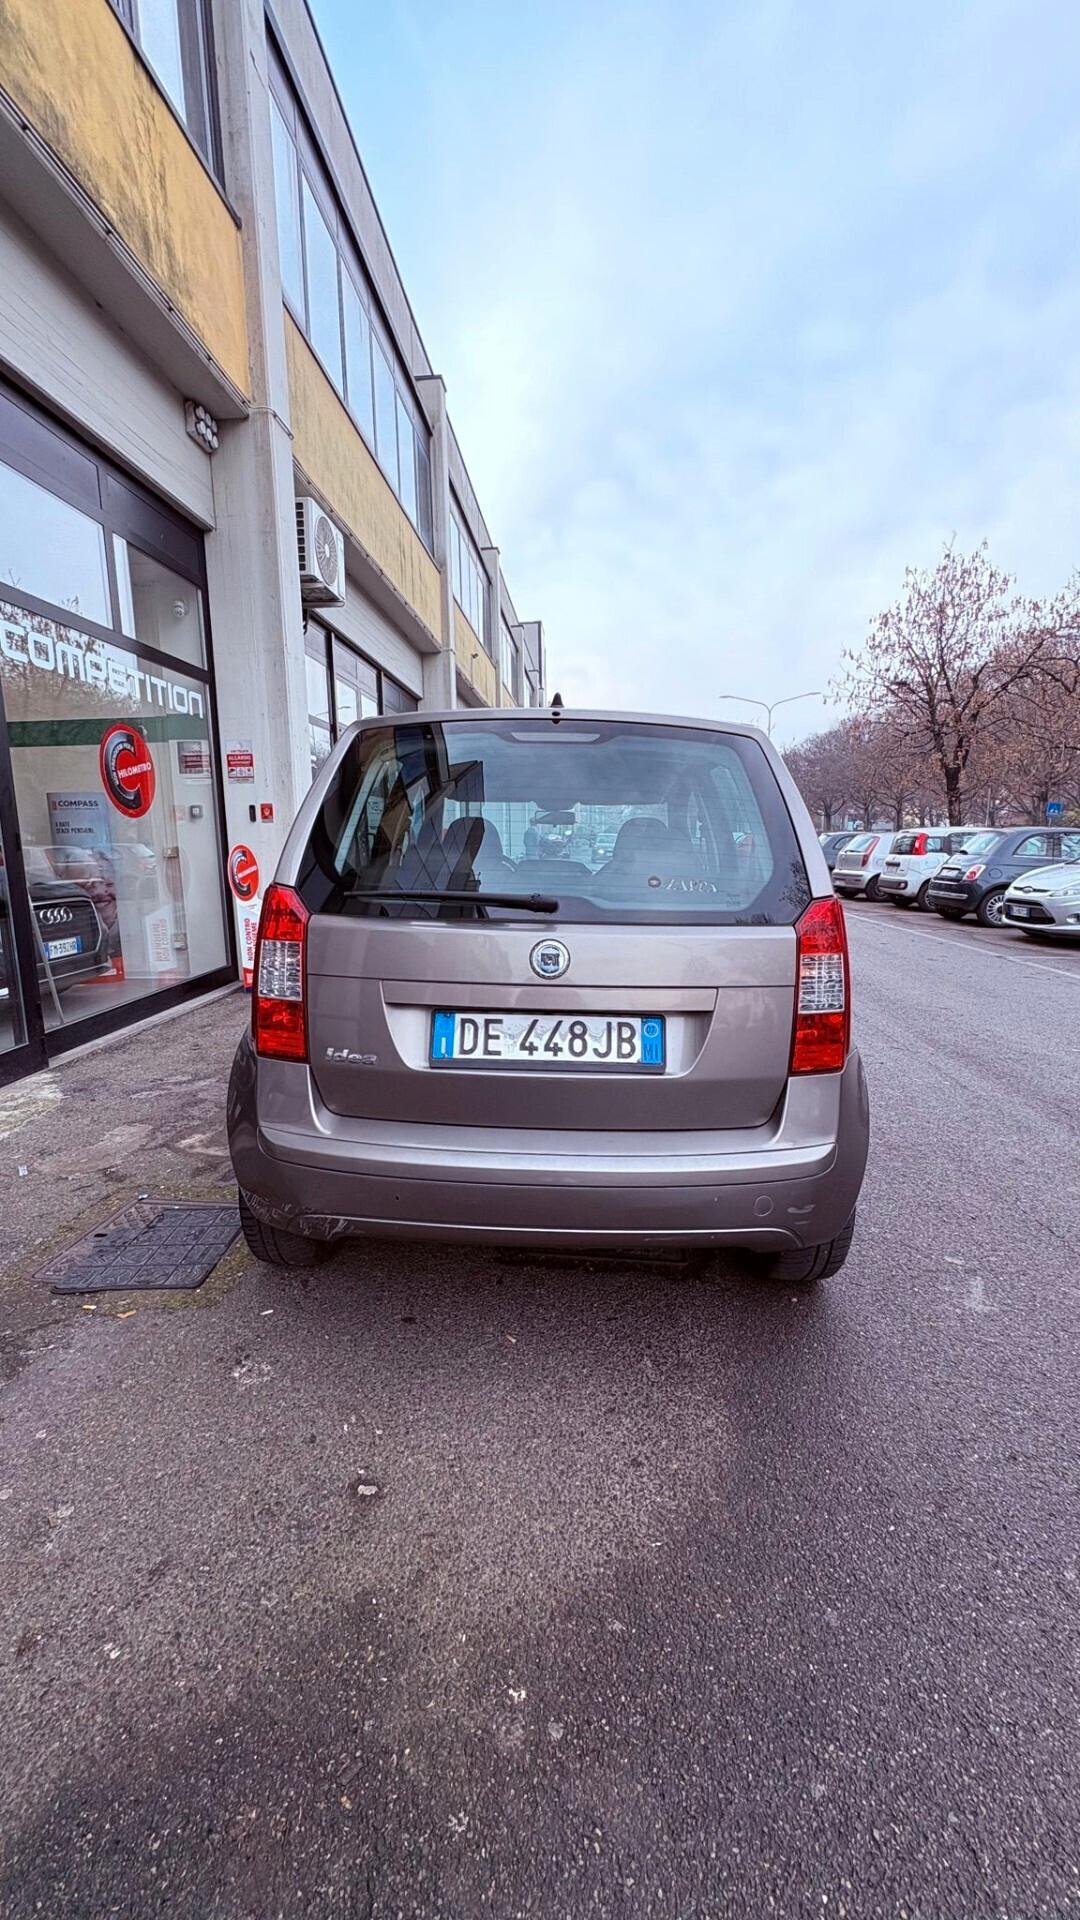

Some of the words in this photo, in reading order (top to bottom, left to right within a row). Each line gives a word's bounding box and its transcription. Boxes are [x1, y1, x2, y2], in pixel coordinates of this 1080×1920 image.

[0, 620, 204, 719] COMPETITION
[243, 918, 252, 945] CONTRO
[458, 1017, 503, 1056] DE
[519, 1019, 637, 1060] 448JB
